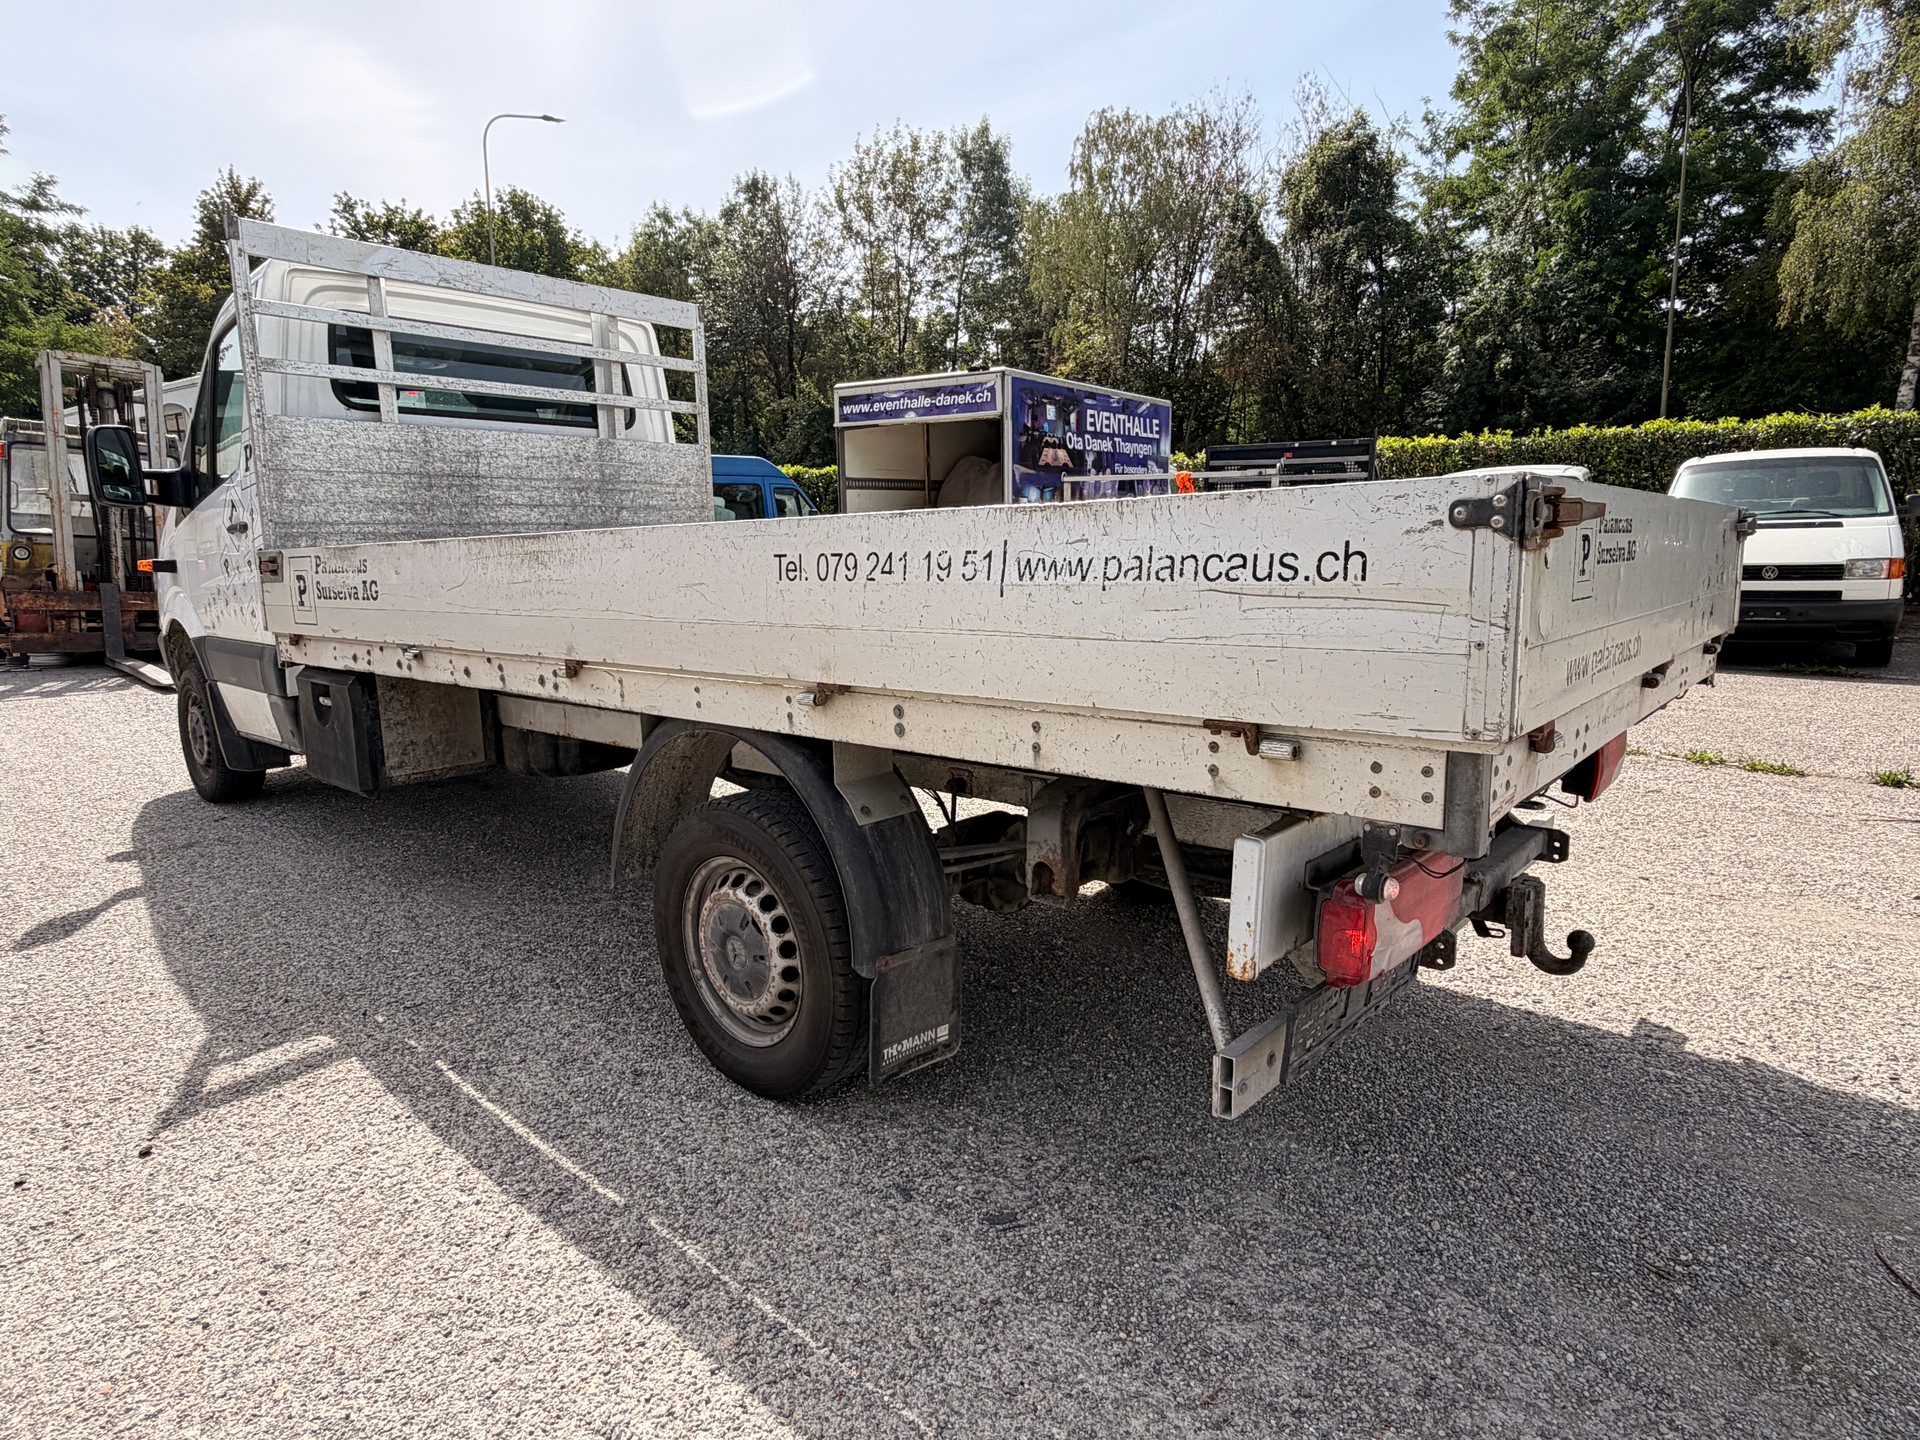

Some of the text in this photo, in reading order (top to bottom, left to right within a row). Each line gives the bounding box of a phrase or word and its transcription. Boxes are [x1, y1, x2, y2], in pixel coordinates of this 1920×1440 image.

[843, 390, 992, 414] www.eventhalle-danek.ch
[1086, 409, 1160, 439] EVENTHALLE
[1066, 431, 1152, 458] Ota Danek Thayngen
[1580, 533, 1591, 577] P
[1626, 540, 1636, 562] AG
[774, 540, 1367, 592] Tel. 079 241 19 51 www.palancaus.ch
[296, 574, 307, 607] P
[361, 579, 379, 601] AG
